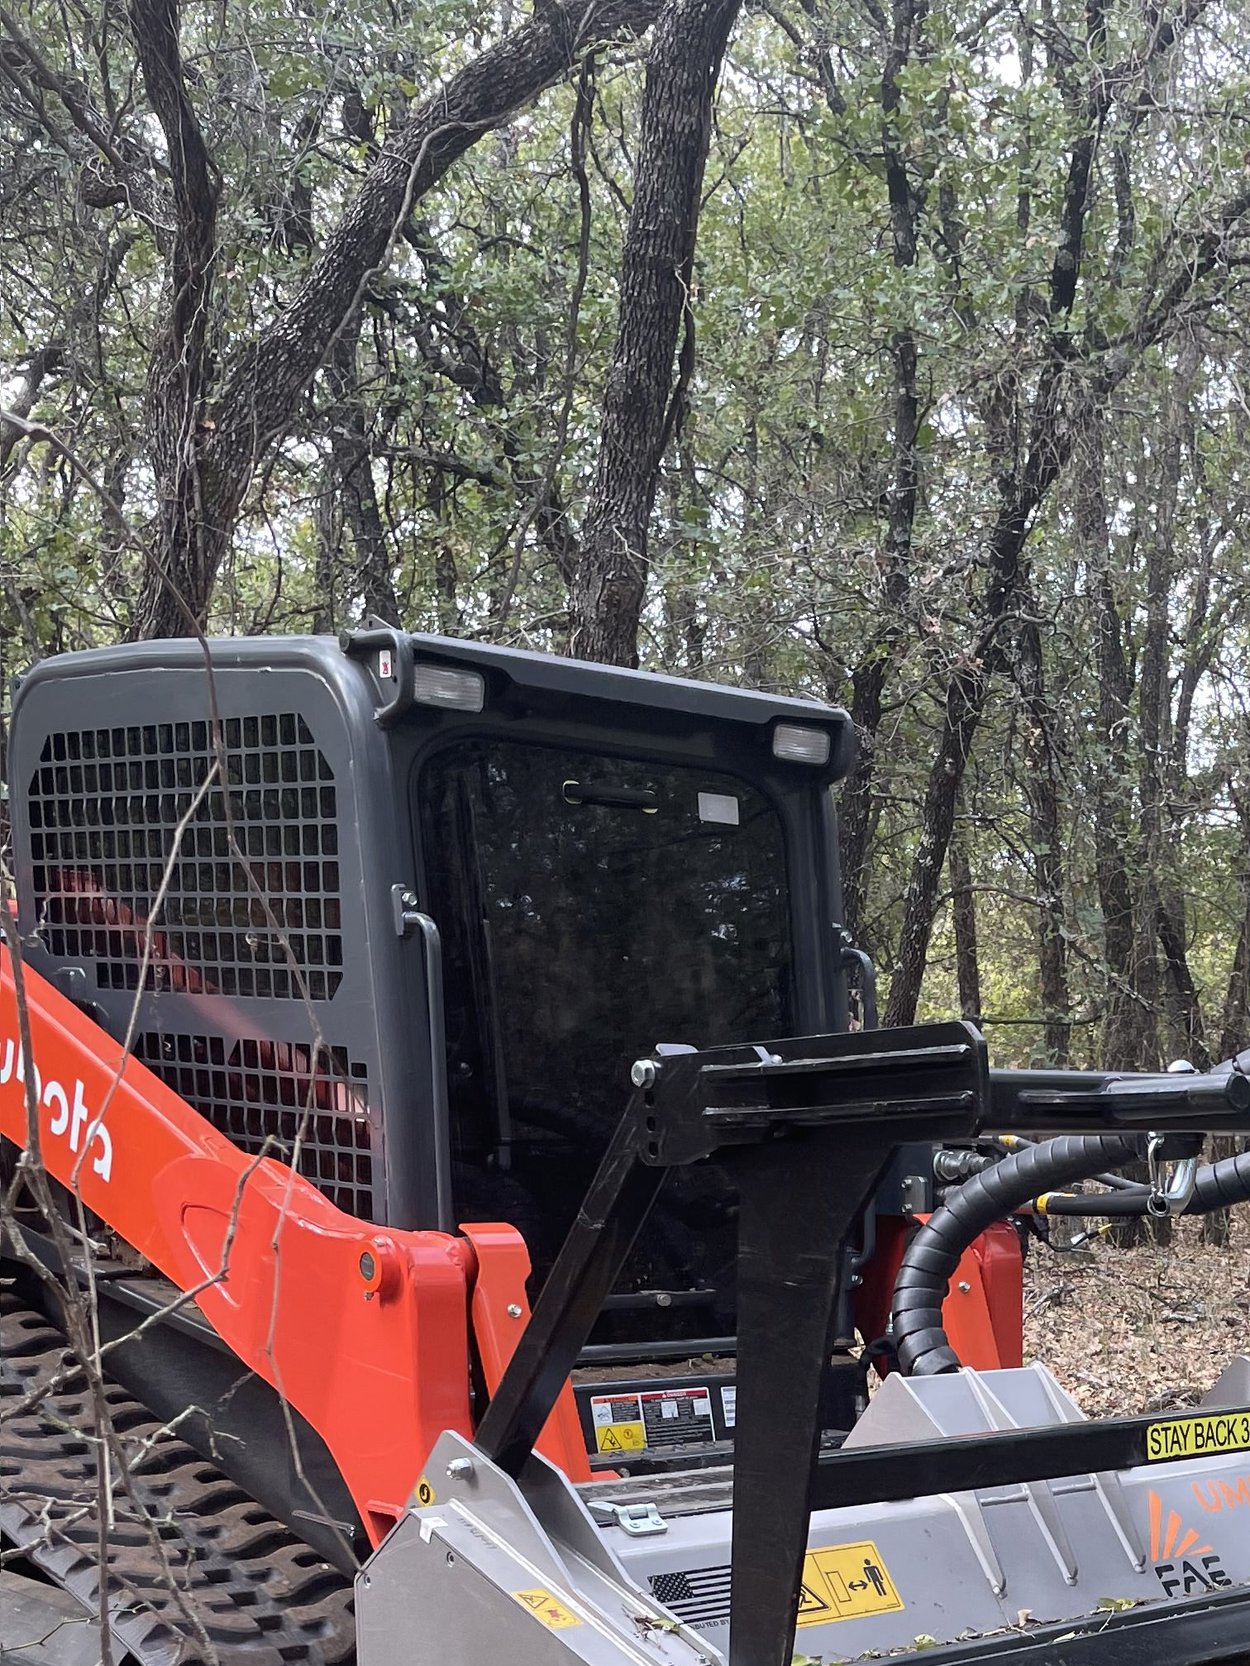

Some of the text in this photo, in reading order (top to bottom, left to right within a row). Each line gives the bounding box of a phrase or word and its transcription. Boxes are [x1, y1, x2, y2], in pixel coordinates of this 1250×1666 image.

[1150, 1423, 1191, 1455] STAY
[1194, 1417, 1239, 1449] BACK
[1154, 1555, 1233, 1598] FAE
